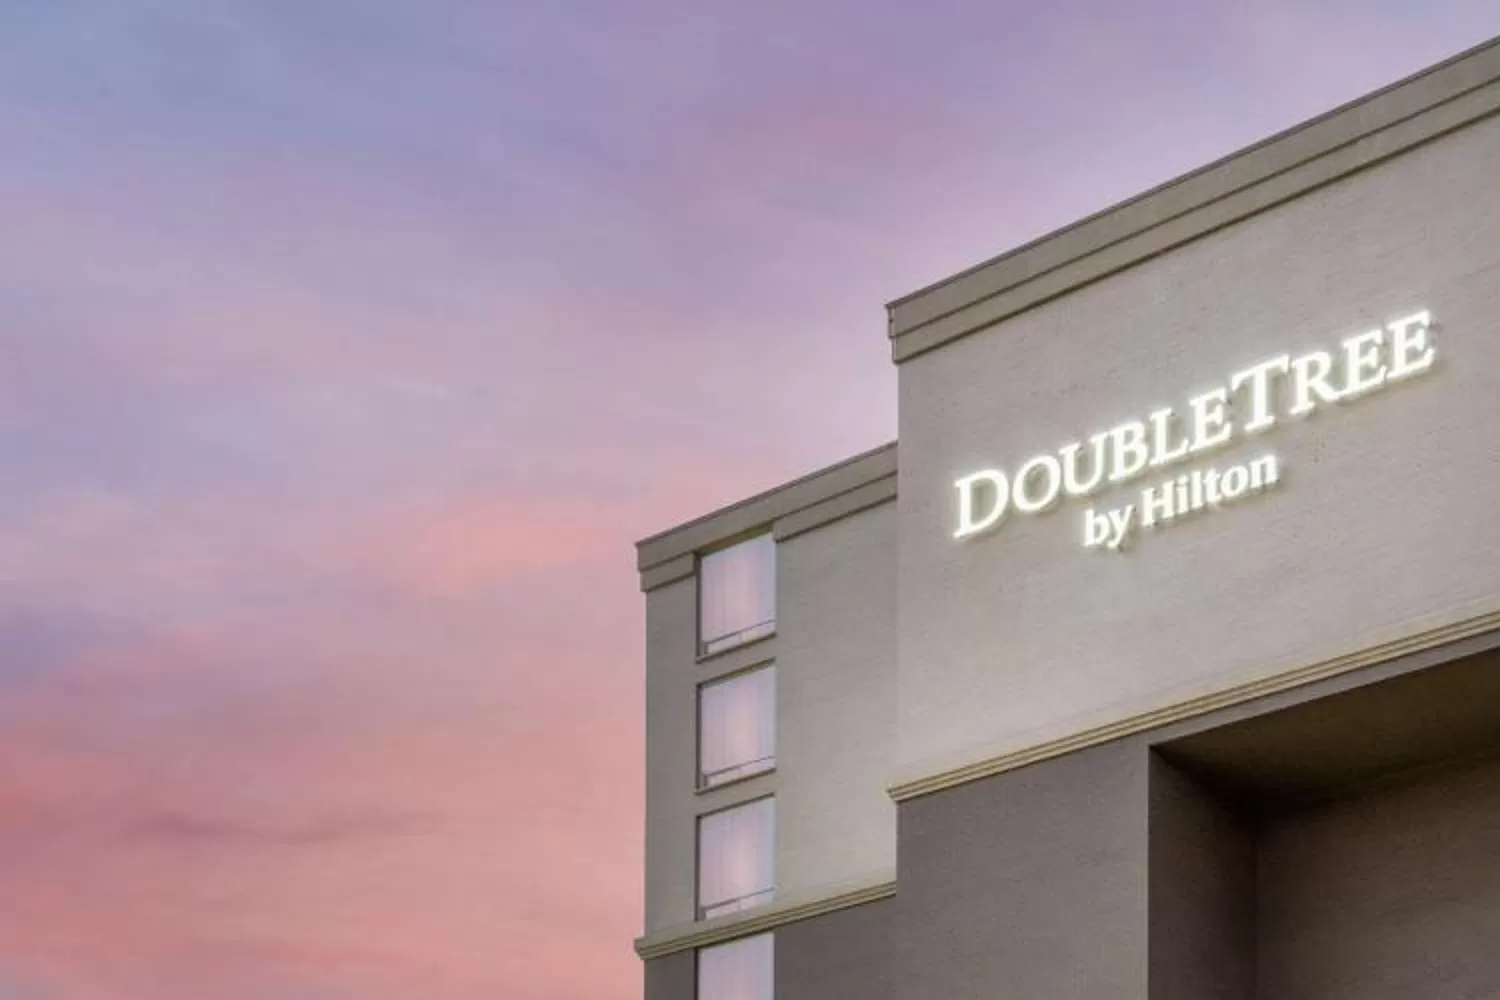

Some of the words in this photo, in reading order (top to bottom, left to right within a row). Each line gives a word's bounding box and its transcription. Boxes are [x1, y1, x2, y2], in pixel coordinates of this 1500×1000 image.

[952, 310, 1436, 539] DOUBLETREE
[1083, 507, 1134, 549] by
[1141, 453, 1279, 528] Hilton
